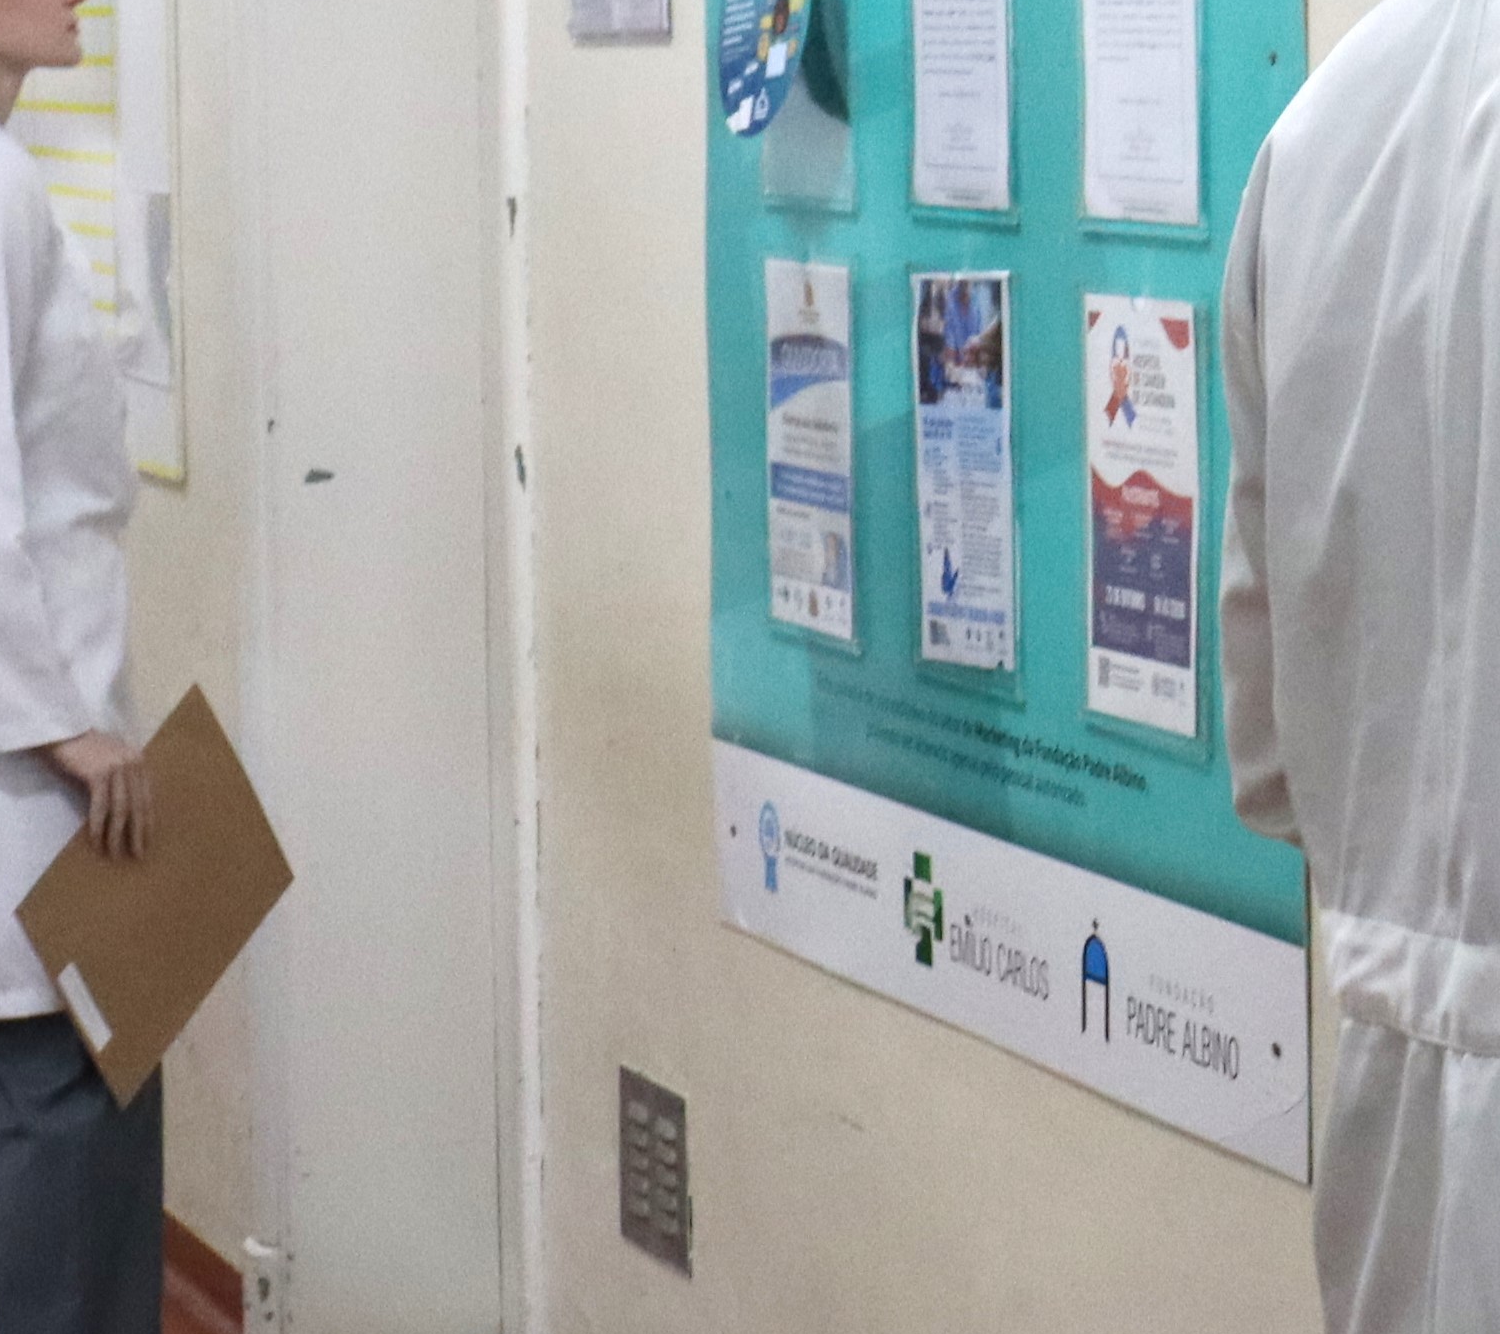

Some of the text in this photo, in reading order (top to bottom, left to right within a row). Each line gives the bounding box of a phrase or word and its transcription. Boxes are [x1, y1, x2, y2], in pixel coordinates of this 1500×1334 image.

[996, 942, 1050, 1001] CARLOS
[1125, 995, 1240, 1080] PADRE ALBINO
